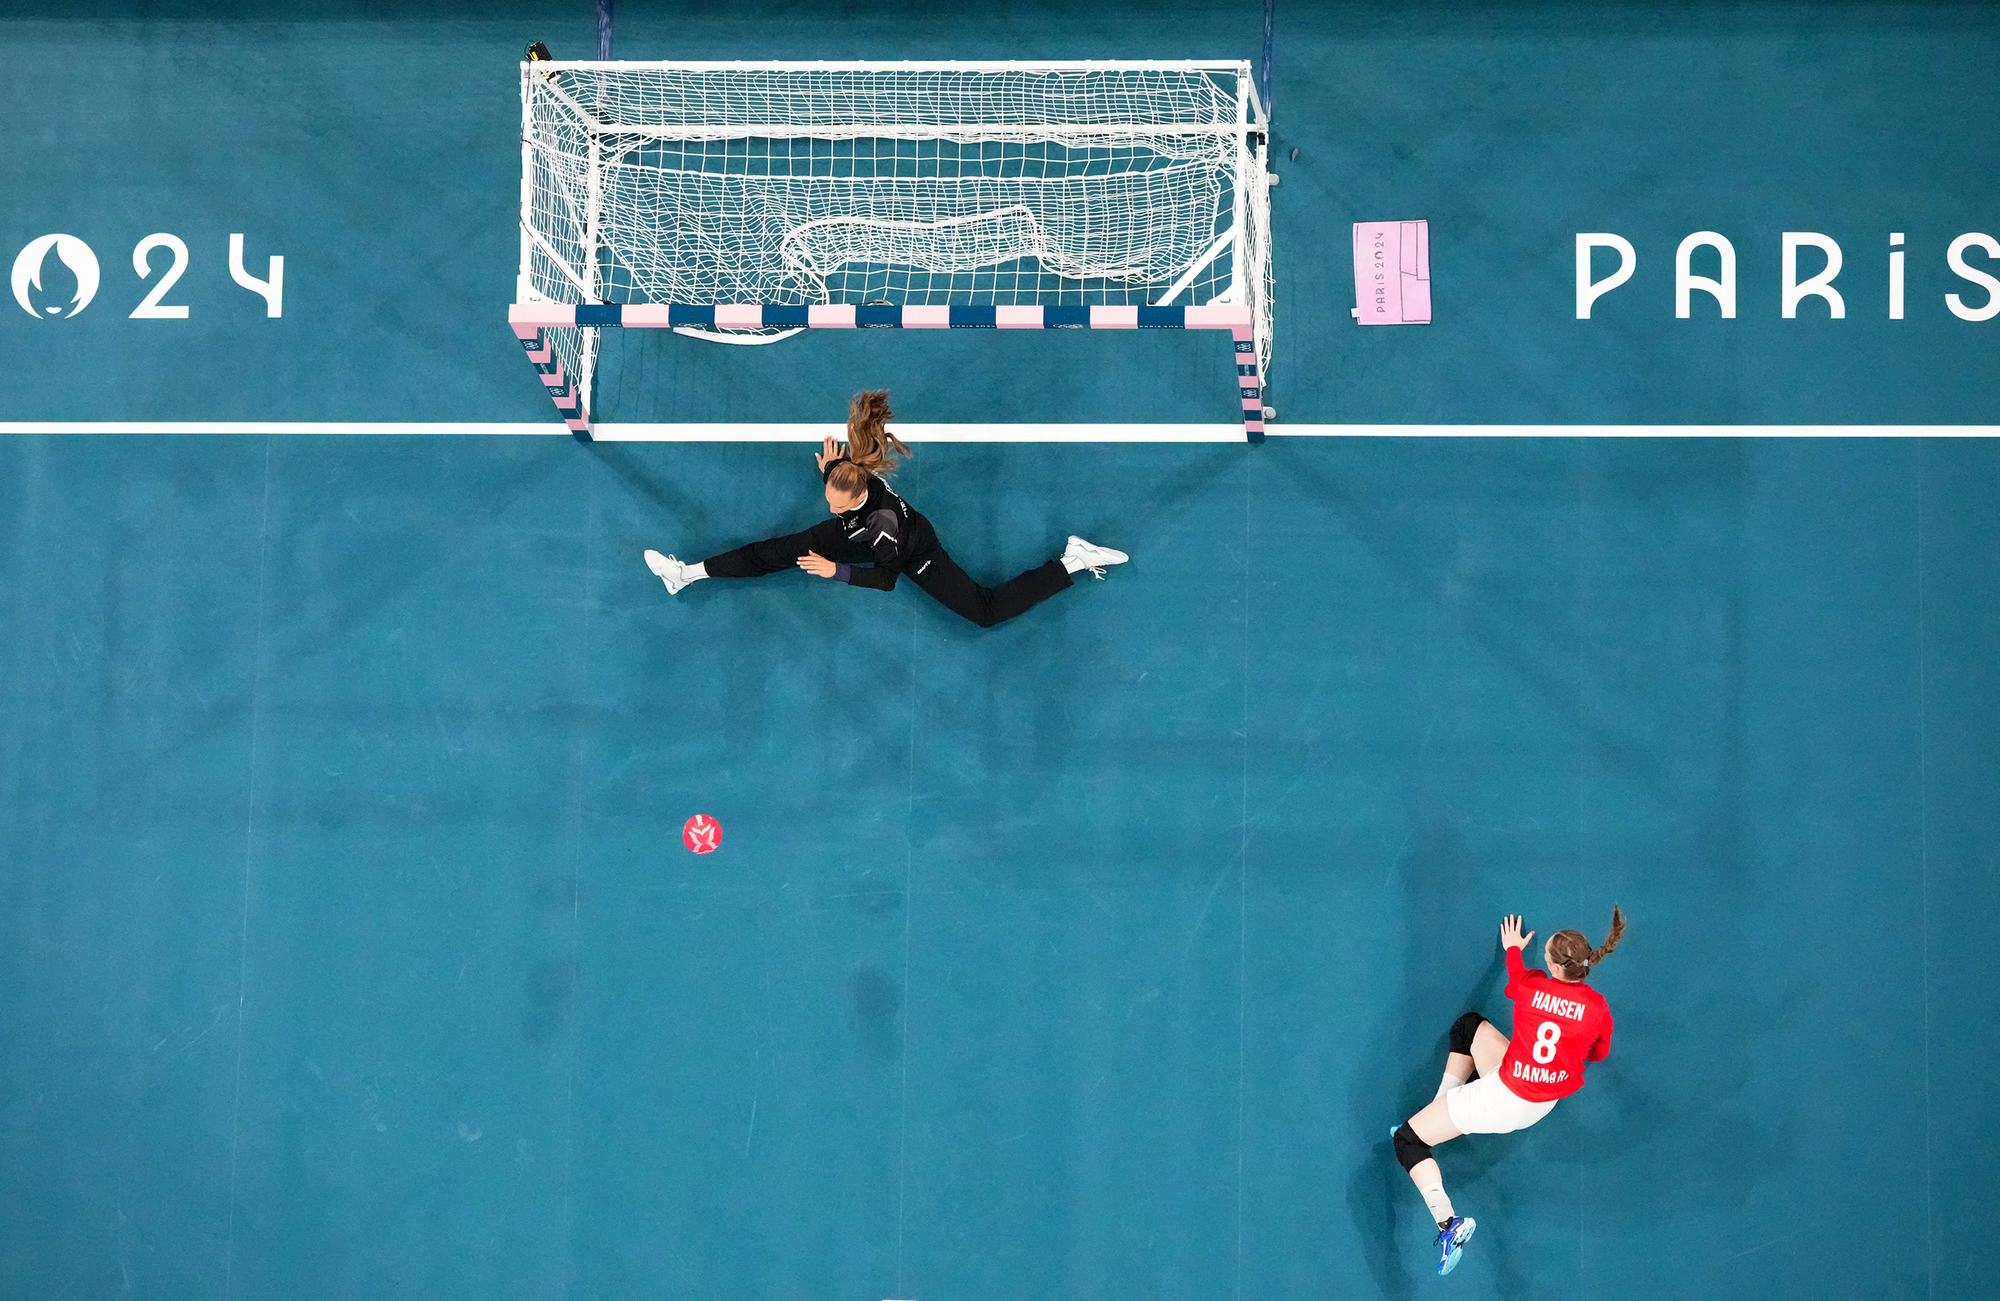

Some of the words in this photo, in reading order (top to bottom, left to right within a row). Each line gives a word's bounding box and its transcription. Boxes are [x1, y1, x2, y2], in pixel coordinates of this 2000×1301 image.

[1374, 232, 1385, 269] 2024
[1375, 273, 1386, 313] PARIS
[1576, 230, 2000, 322] PARIS
[1531, 990, 1586, 1021] HANSEN
[1532, 1021, 1562, 1064] 8
